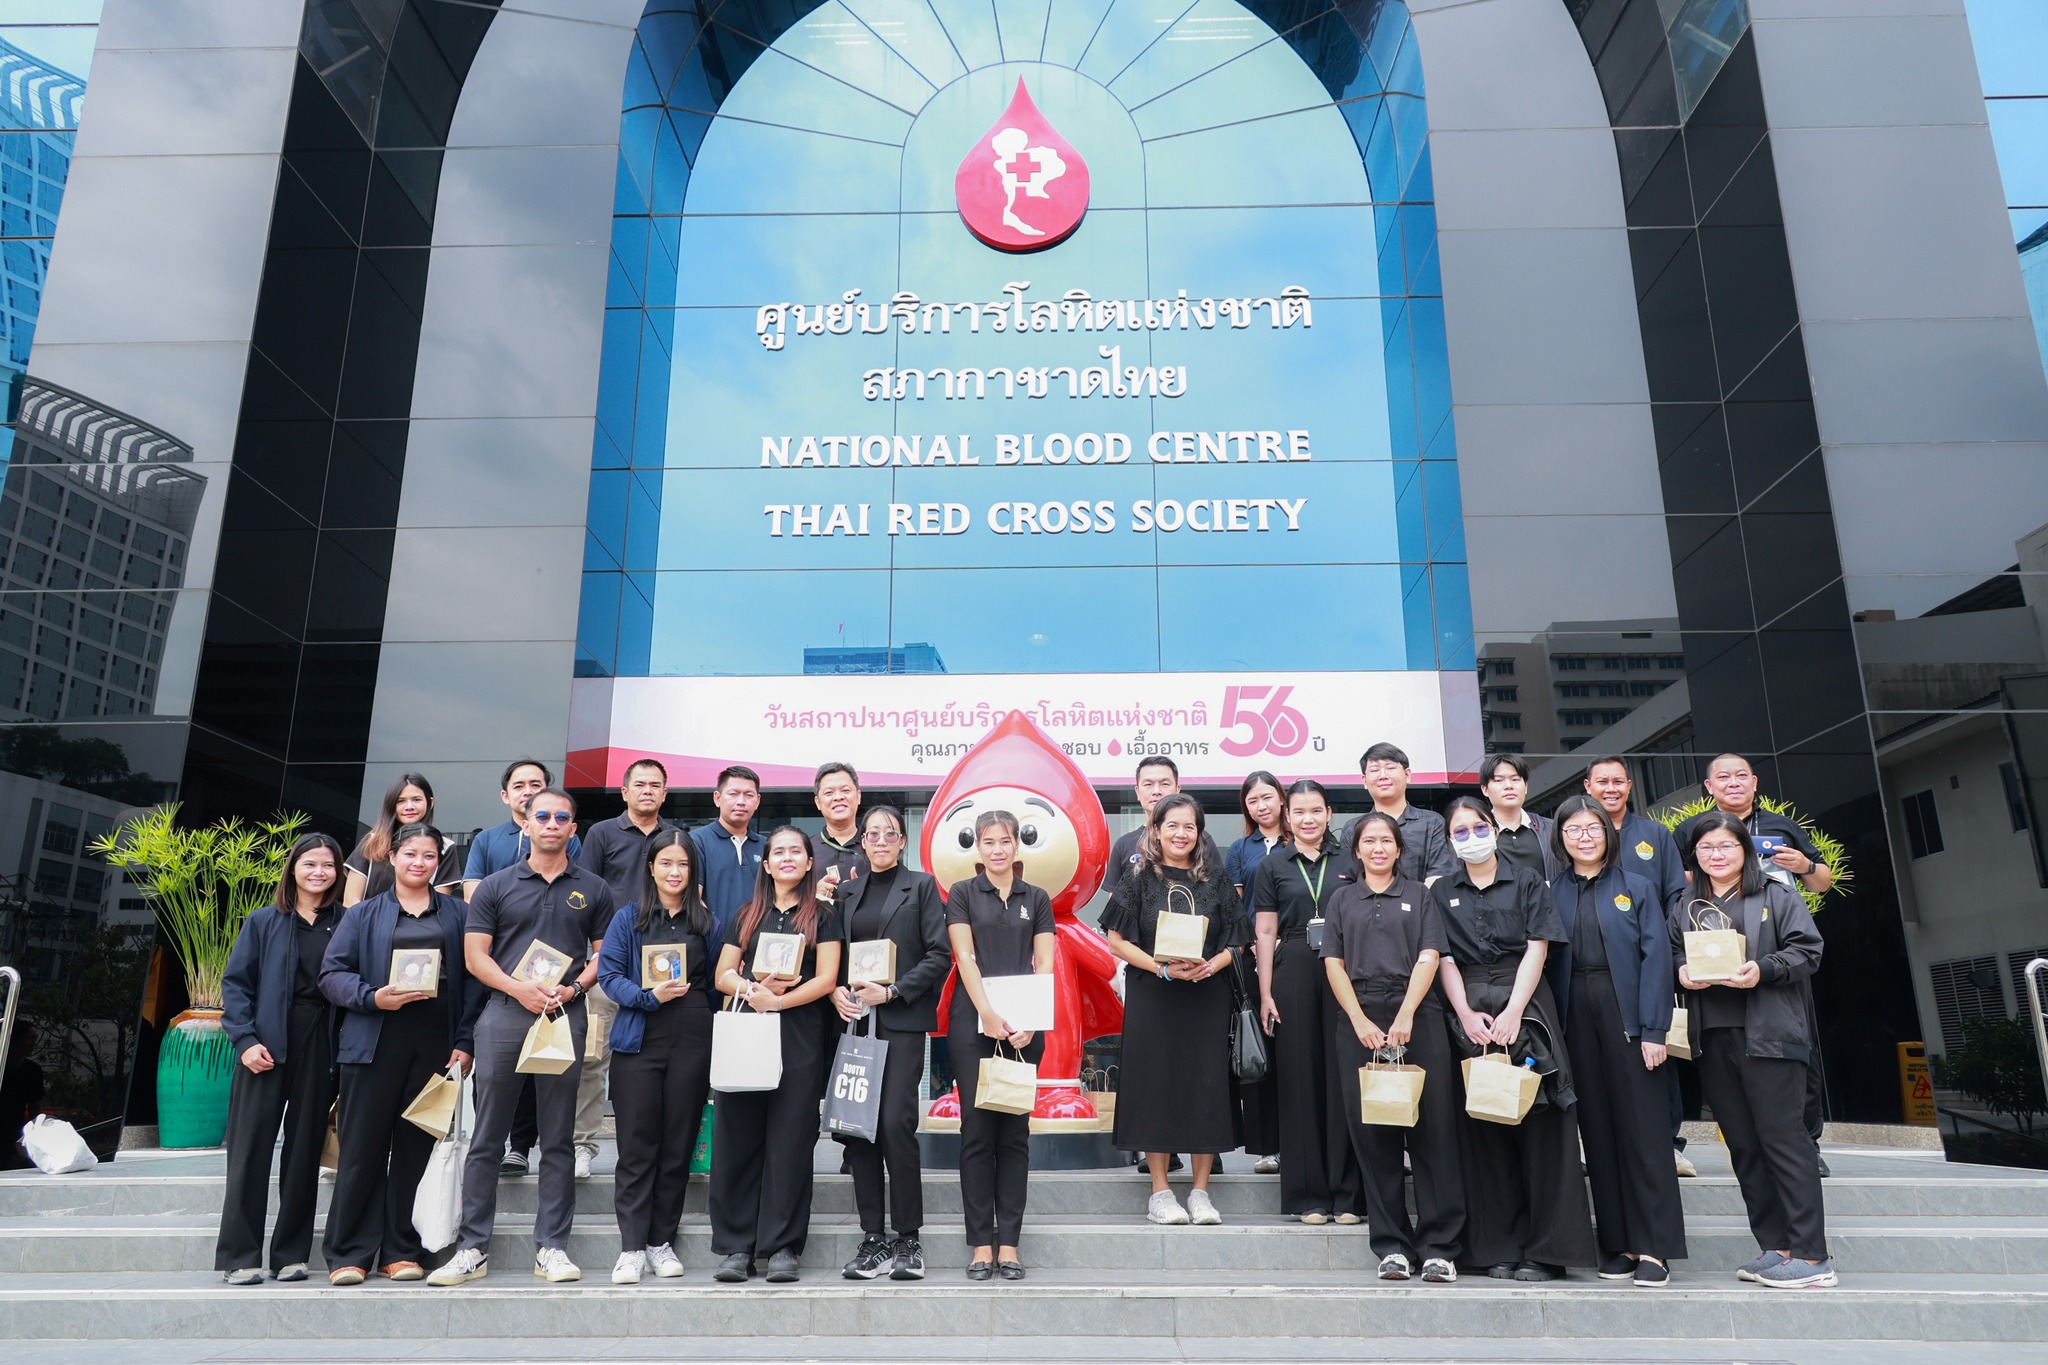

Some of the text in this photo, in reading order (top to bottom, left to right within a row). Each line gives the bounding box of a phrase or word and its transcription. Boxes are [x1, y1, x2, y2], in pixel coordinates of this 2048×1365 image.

[756, 281, 1312, 350] ศูนย์บริการโลหิตแห่งชาติ
[863, 345, 1187, 400] สภากาชาดไทย
[760, 430, 1311, 467] NATIONAL BLOOD CENTRE
[764, 498, 1308, 537] THAI RED CROSS SOCIETY
[764, 700, 1208, 737] วันสถาปนาศูนย์บริกรโลหิตแห่งชาติ
[1219, 685, 1326, 757] 56 ปี
[911, 743, 975, 764] คุณภา
[1127, 730, 1209, 756] เอื้ออาทร
[834, 1073, 869, 1103] C16
[843, 1063, 866, 1076] BOOTH
